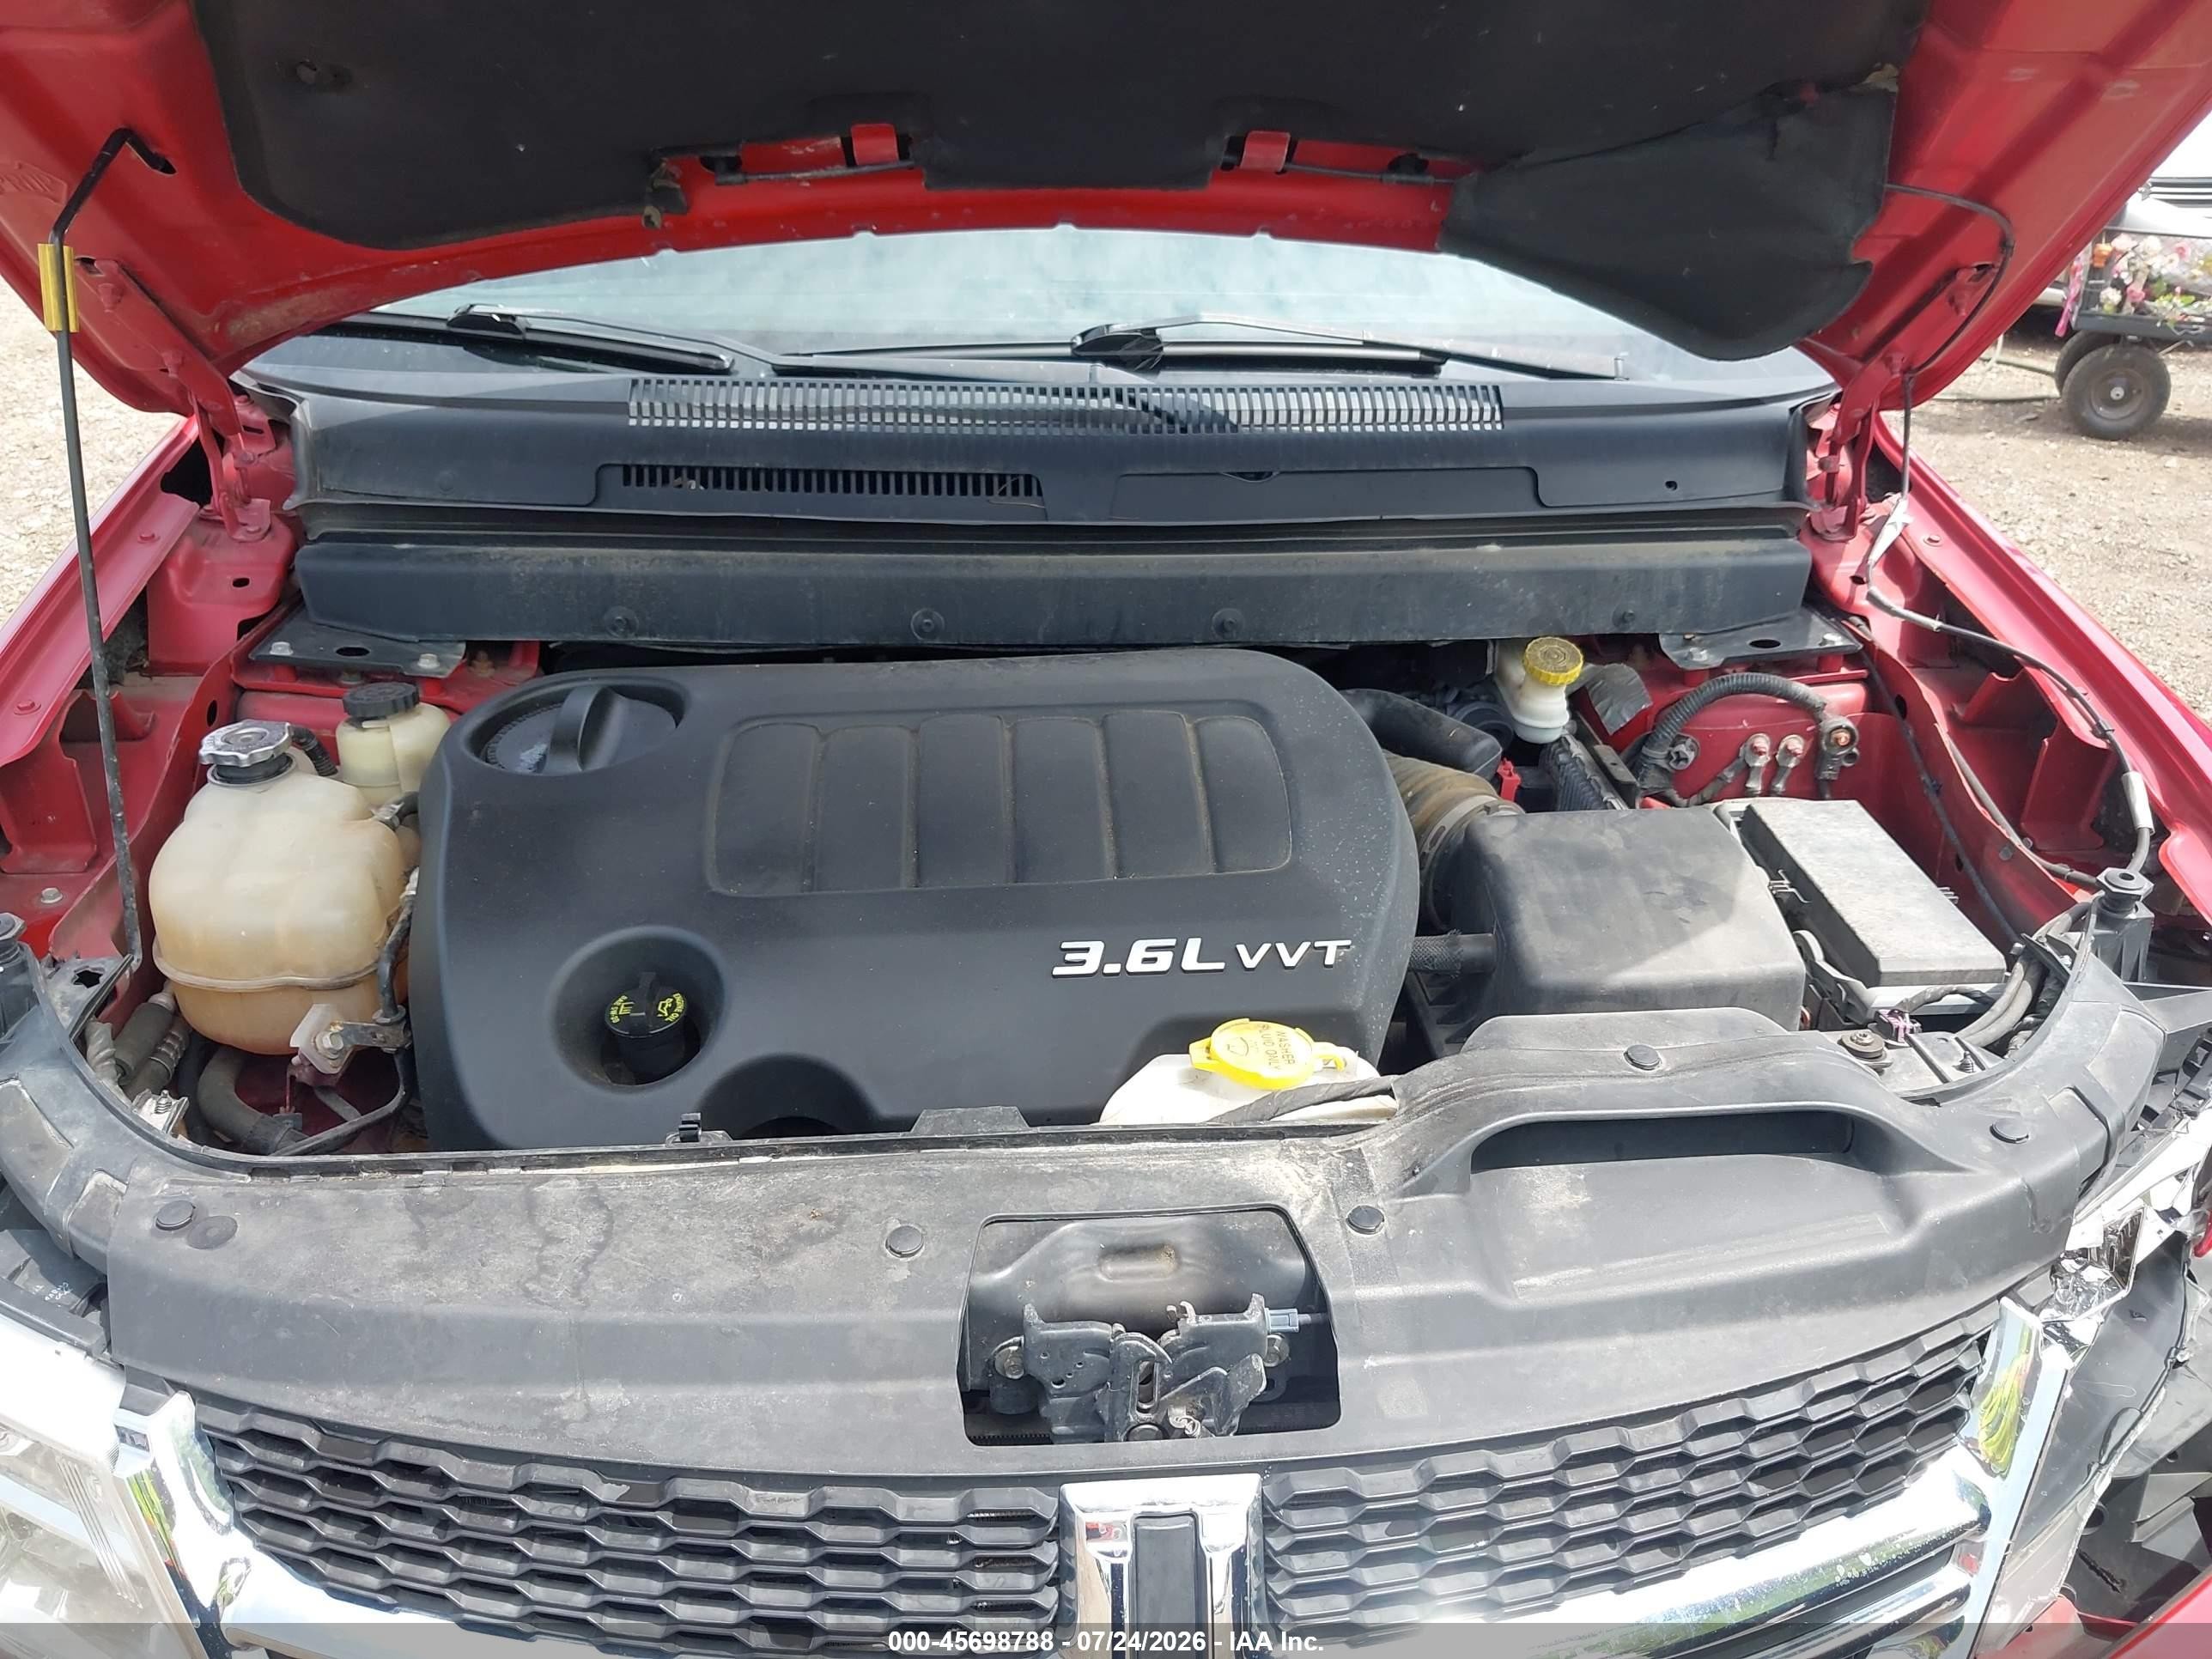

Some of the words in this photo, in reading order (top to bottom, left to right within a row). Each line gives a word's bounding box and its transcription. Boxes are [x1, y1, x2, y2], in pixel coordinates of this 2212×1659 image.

[1052, 938, 1225, 978] 3.6L
[1236, 939, 1352, 972] VVT
[672, 993, 684, 1012] ENGINE
[665, 1012, 680, 1022] OIL
[1276, 1030, 1296, 1065] WASHER
[1264, 1049, 1281, 1070] ONLY
